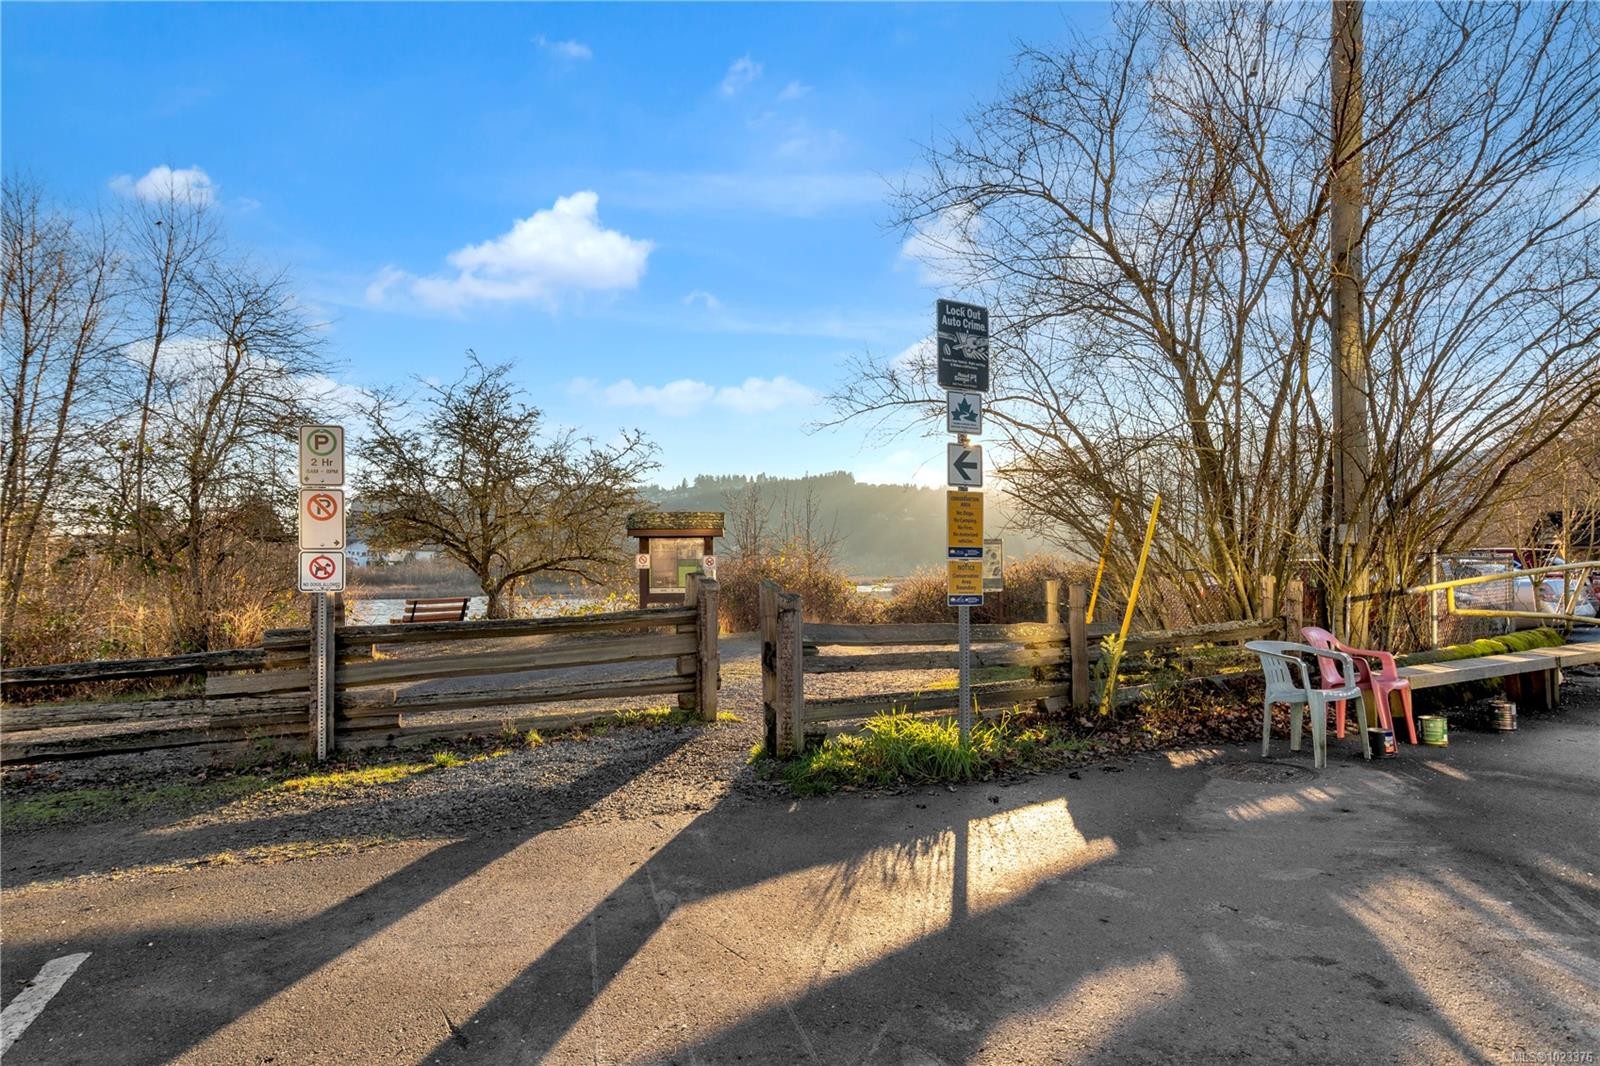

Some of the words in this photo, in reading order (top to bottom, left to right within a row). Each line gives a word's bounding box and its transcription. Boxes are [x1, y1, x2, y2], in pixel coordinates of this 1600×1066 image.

[946, 304, 966, 318] Lock
[967, 308, 981, 320] Out
[942, 314, 961, 328] Auto
[962, 318, 986, 332] Crime.
[314, 434, 330, 450] P
[311, 458, 318, 466] 2
[322, 458, 334, 466] Hr
